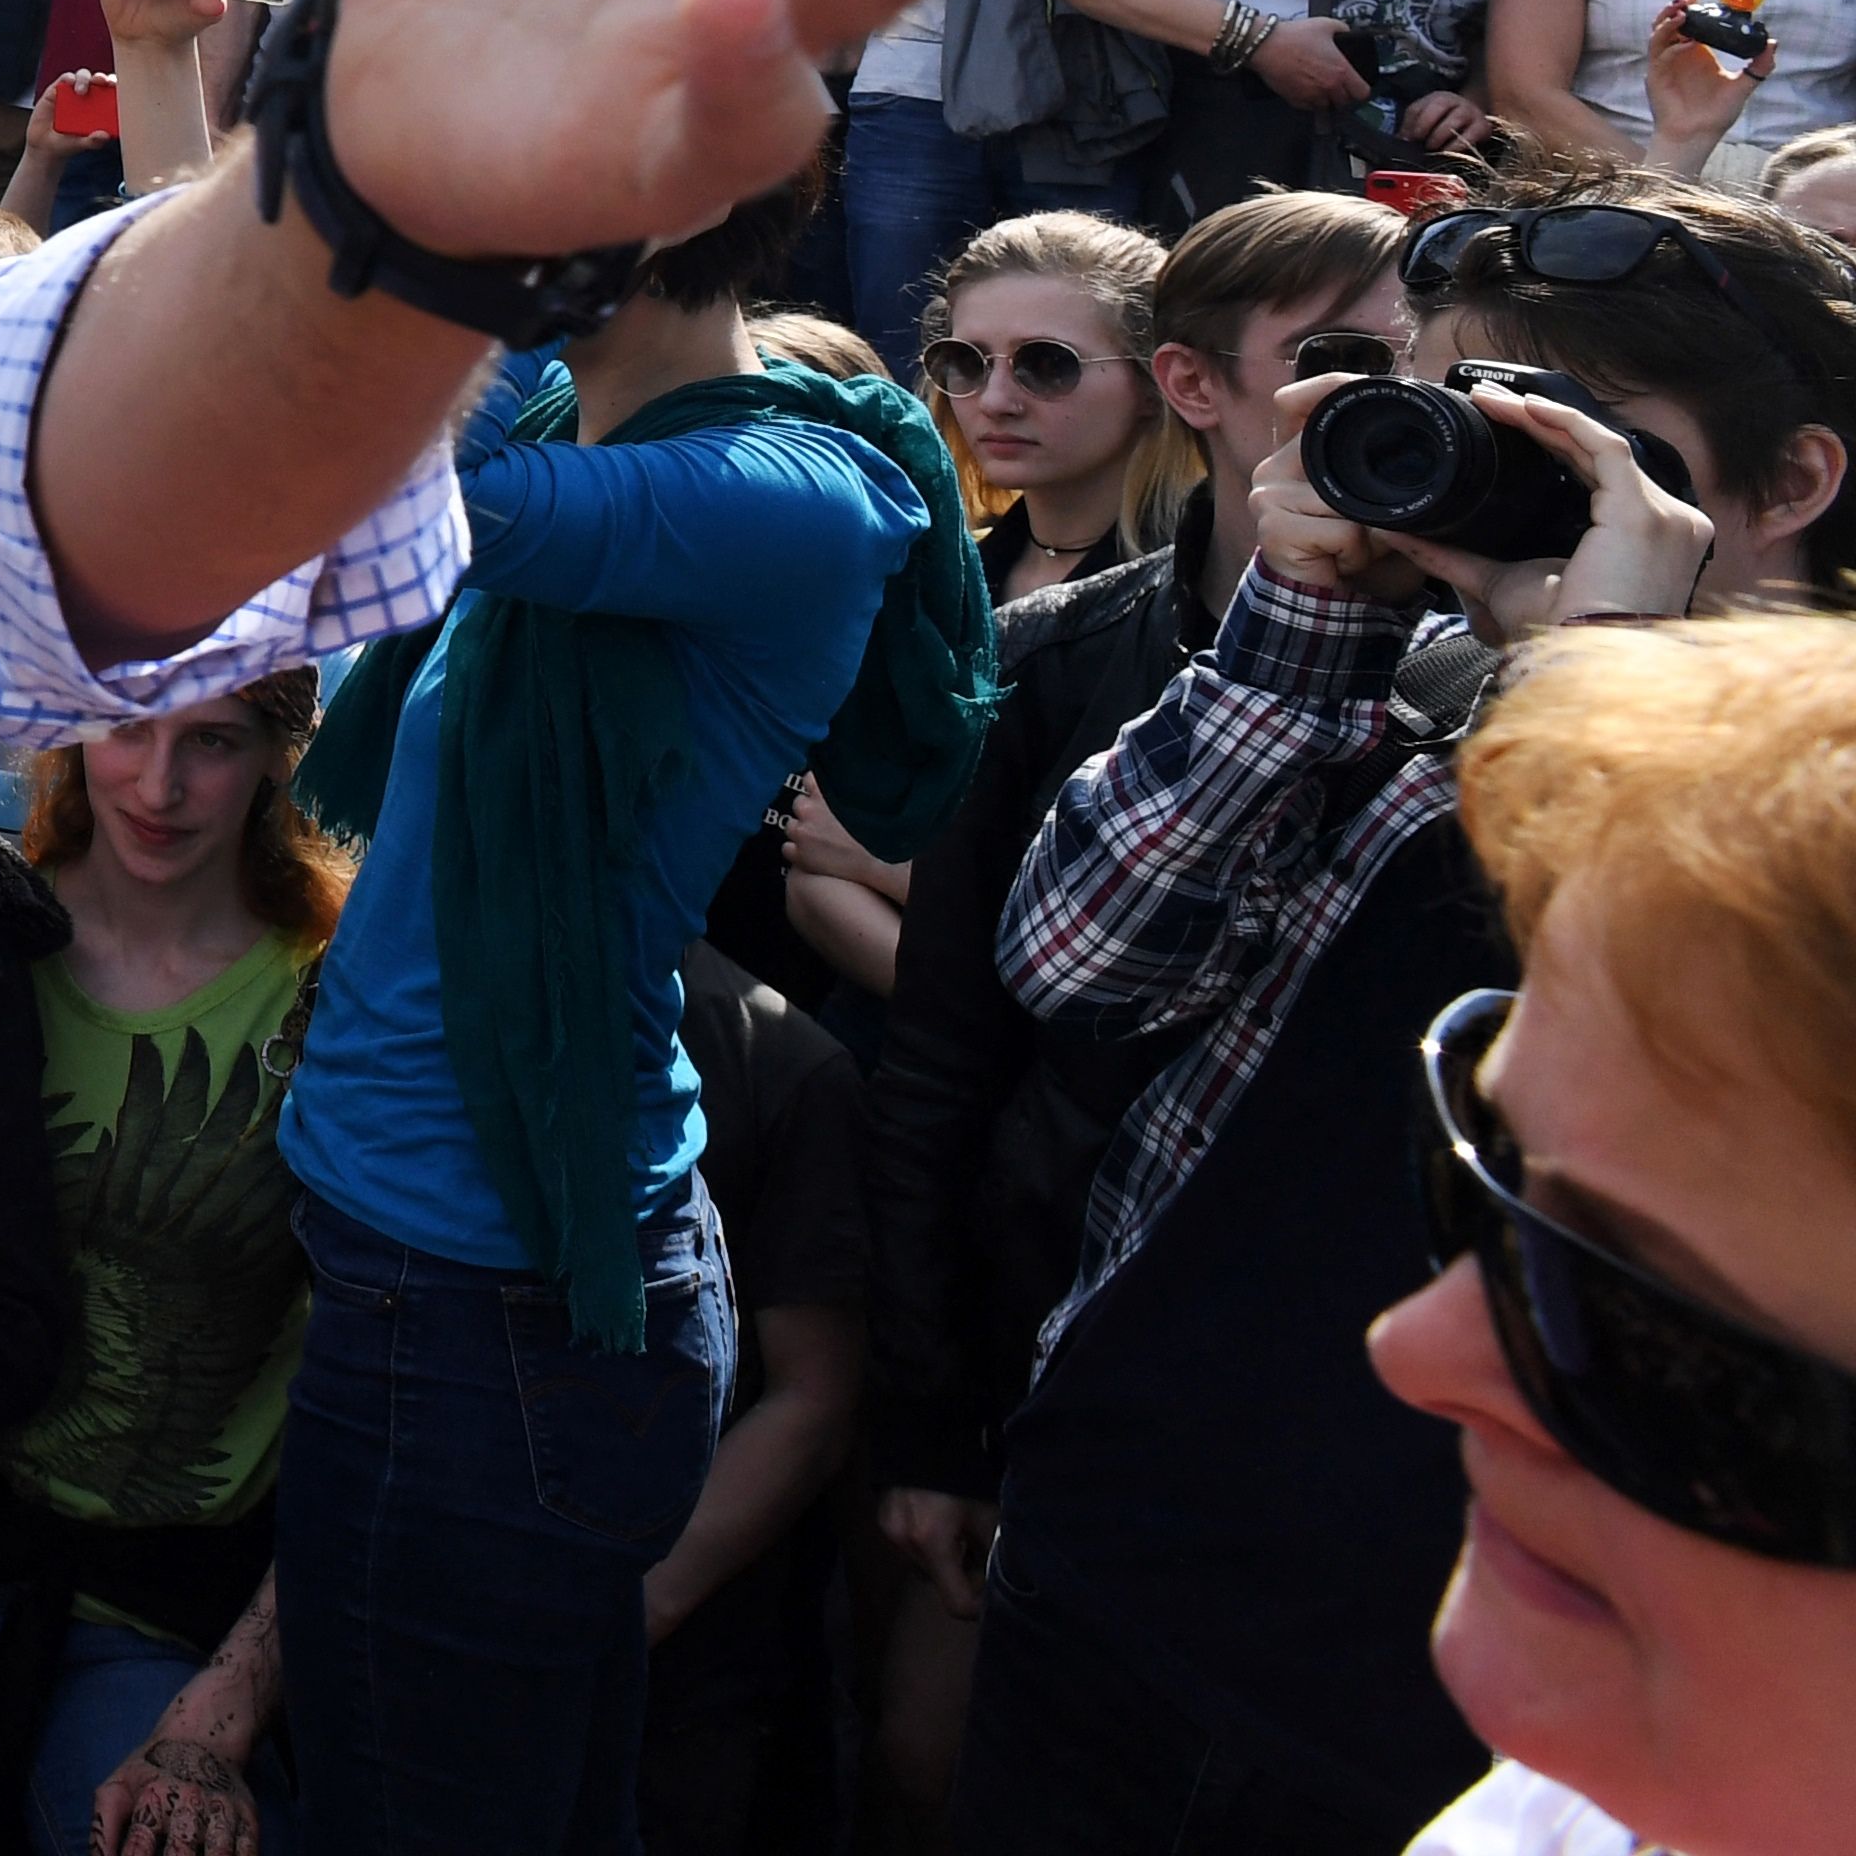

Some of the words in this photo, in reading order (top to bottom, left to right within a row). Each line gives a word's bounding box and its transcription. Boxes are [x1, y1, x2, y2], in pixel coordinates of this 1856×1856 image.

[1458, 365, 1516, 383] Canon
[1316, 409, 1335, 432] CANON
[1335, 393, 1356, 409] ZOOM
[1359, 387, 1377, 397] LENS
